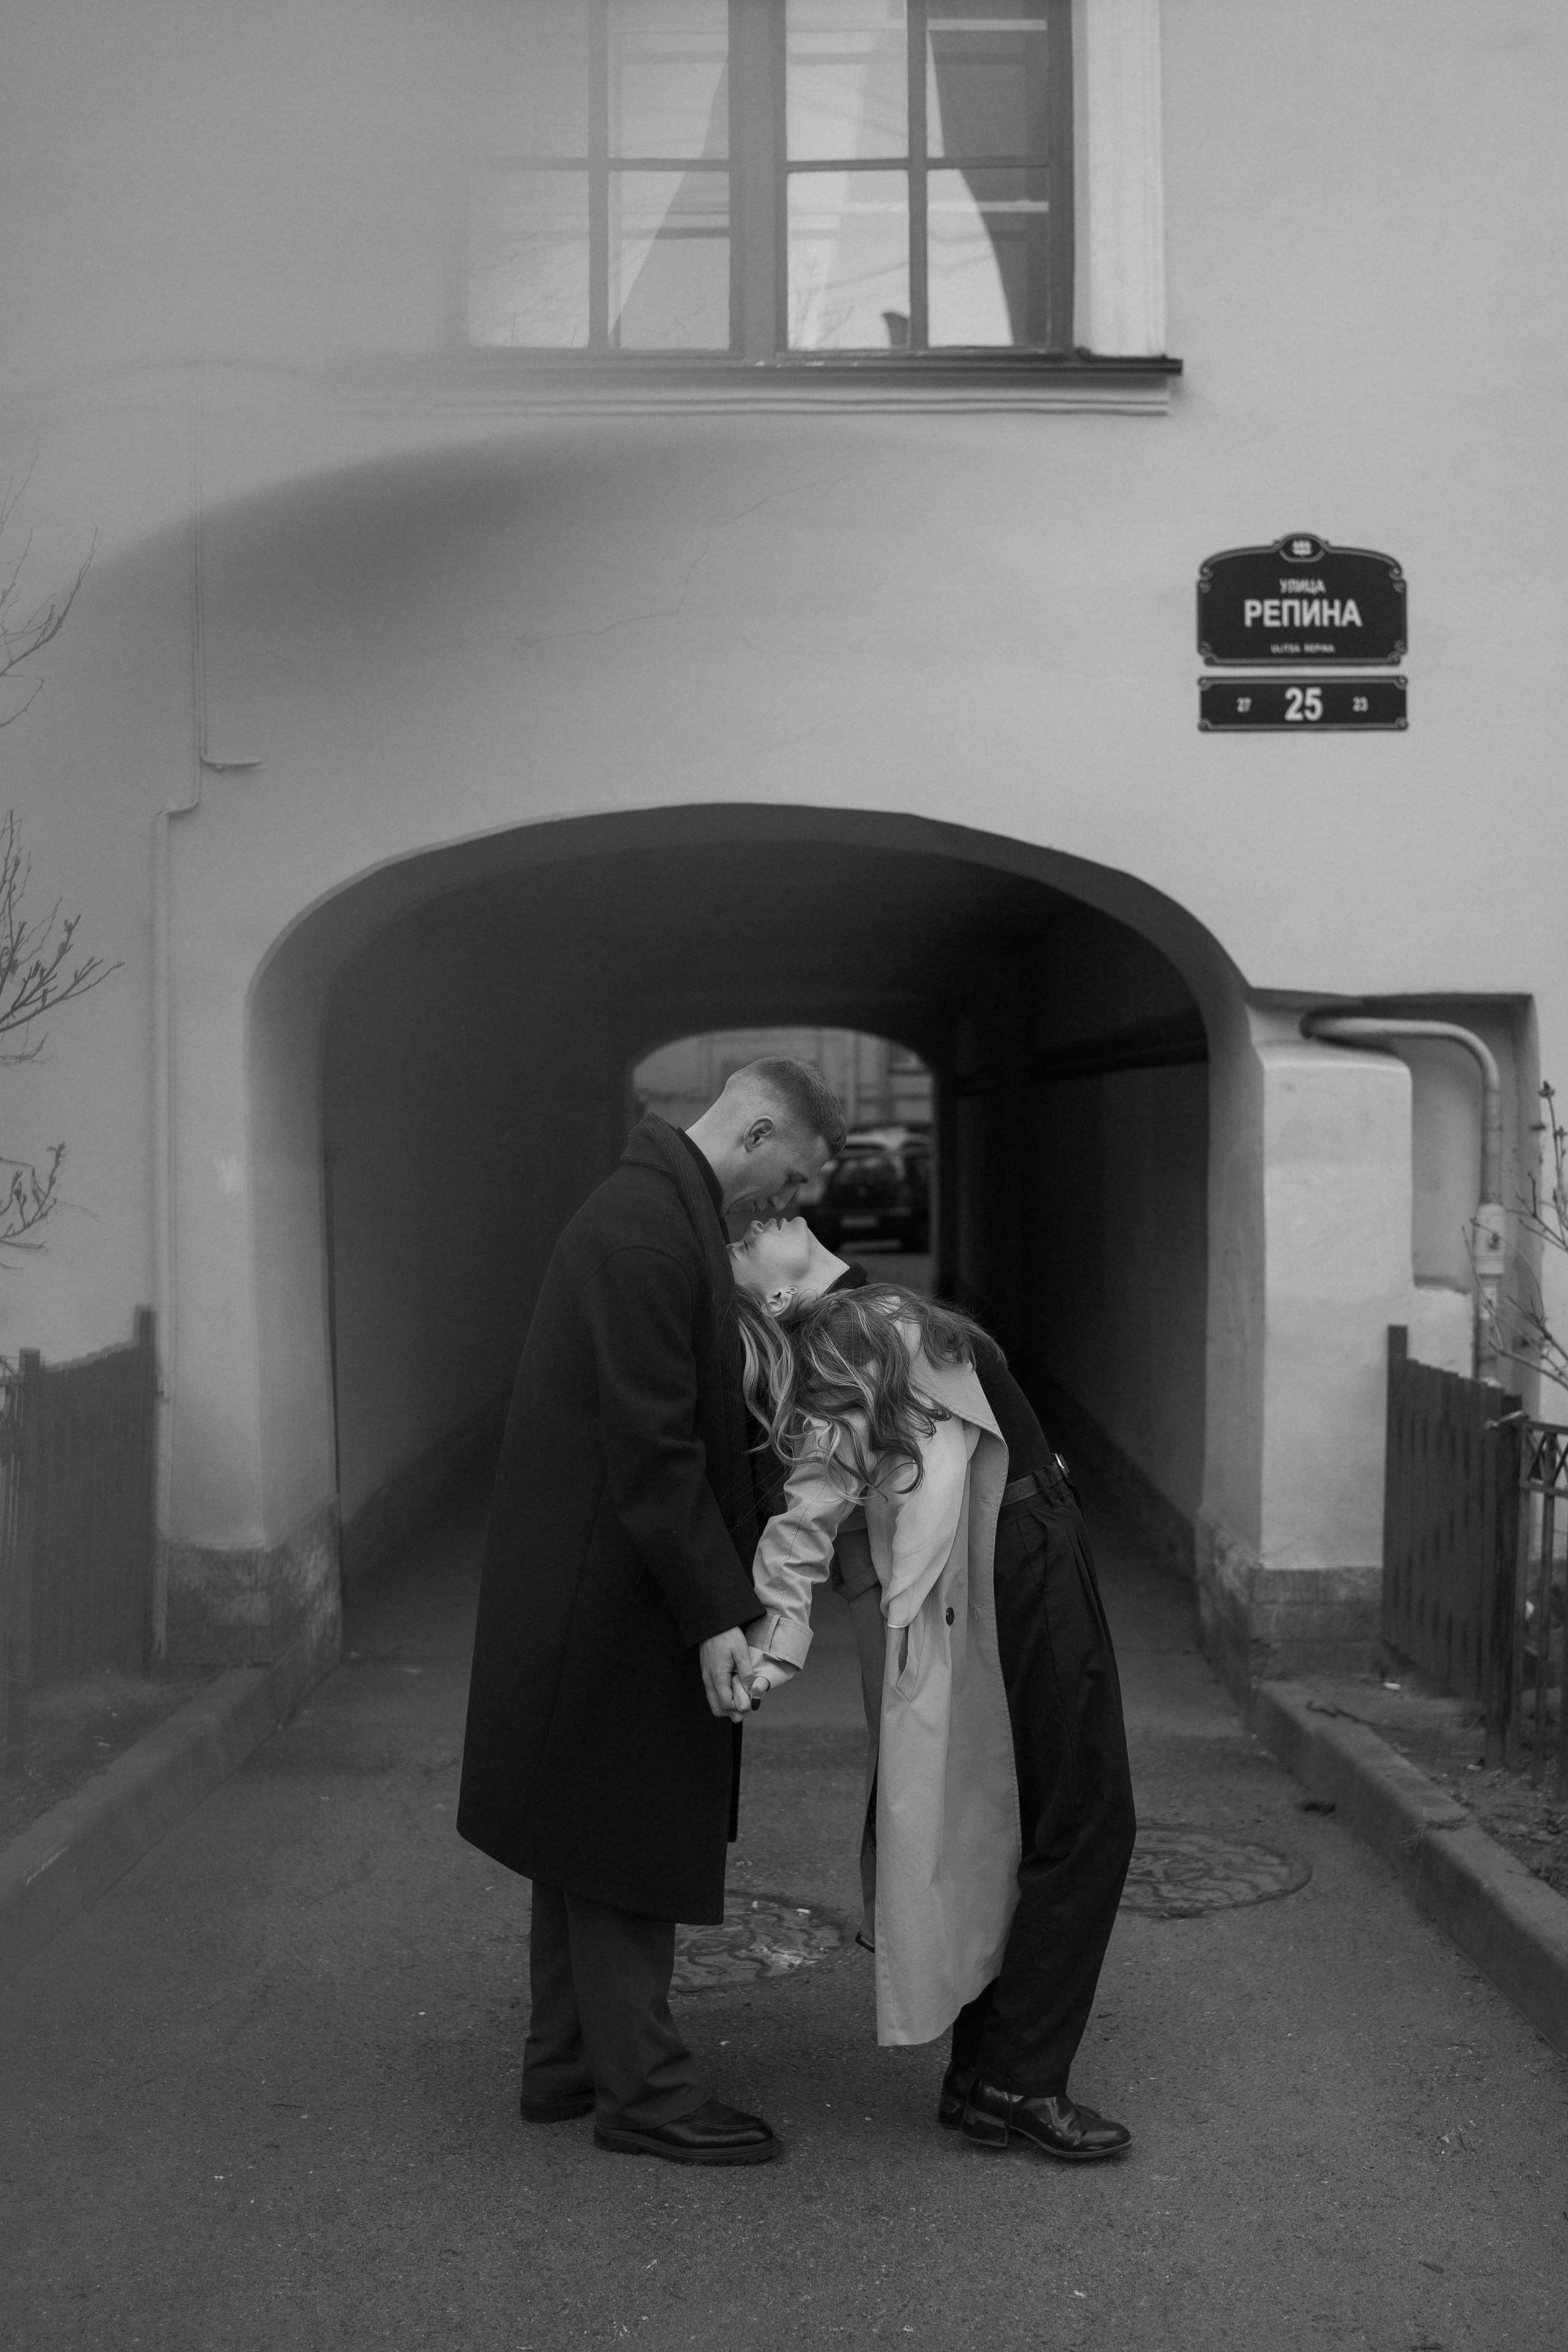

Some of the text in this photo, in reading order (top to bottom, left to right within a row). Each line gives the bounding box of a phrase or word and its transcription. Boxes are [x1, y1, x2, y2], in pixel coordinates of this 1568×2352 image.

[1280, 578, 1326, 595] УЛИЦА
[1244, 599, 1363, 628] РЕПИНА
[1237, 687, 1369, 721] 27 25 23
